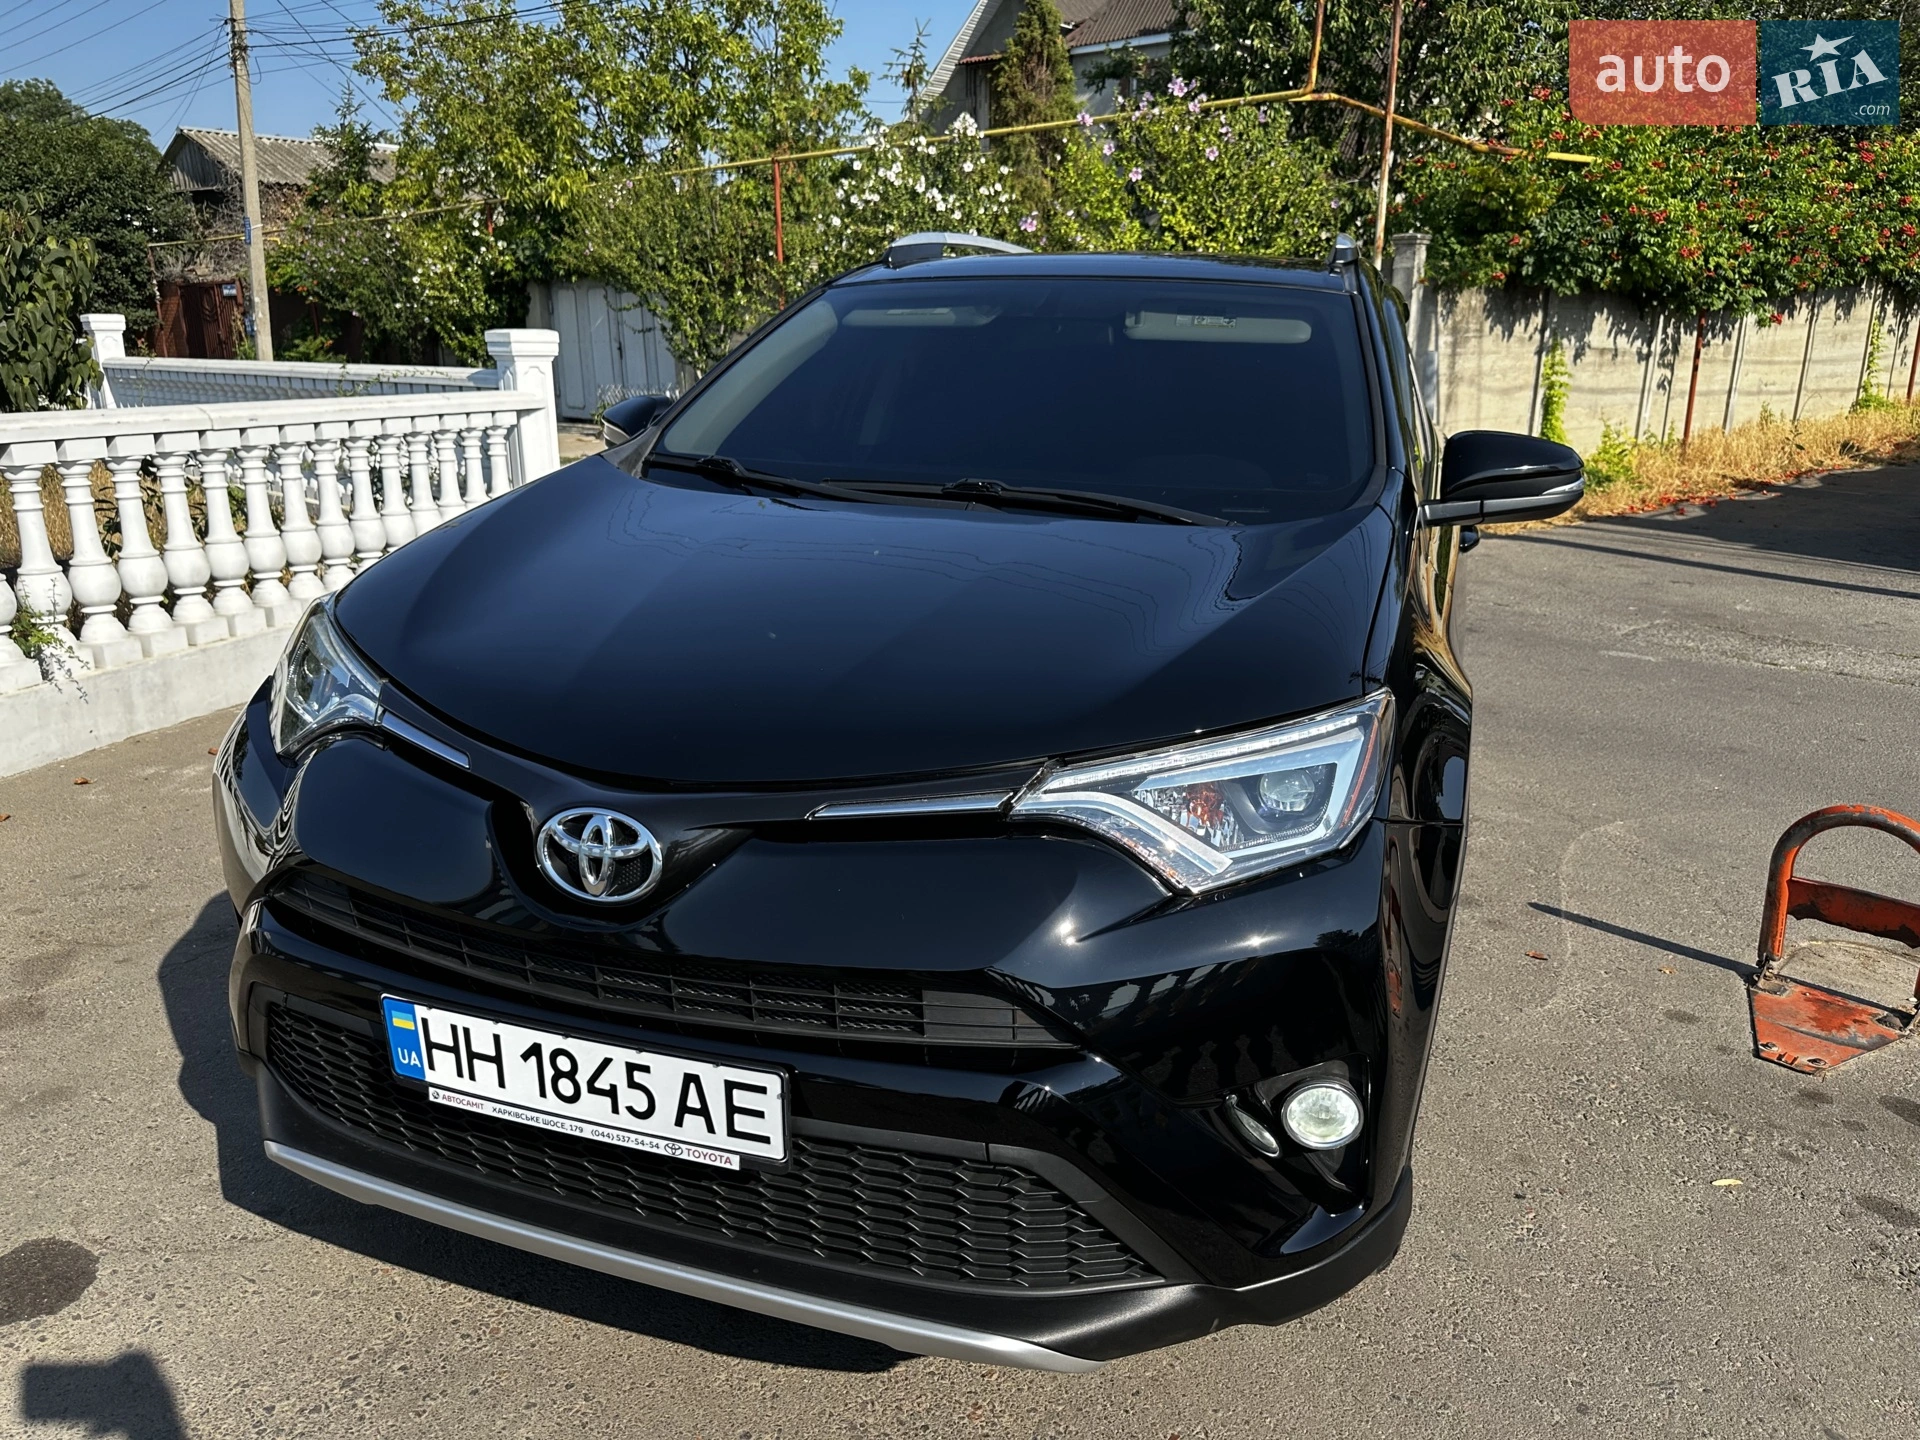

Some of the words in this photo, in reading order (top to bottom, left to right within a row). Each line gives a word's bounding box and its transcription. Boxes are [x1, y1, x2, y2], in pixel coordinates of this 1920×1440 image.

[397, 1047, 421, 1068] UA
[421, 1017, 505, 1089] HH
[520, 1042, 656, 1121] 1845
[674, 1071, 772, 1145] AE
[442, 1094, 484, 1110] АВТОСАМІТ
[492, 1106, 541, 1124] ХАРКІВСЬКЕ
[542, 1118, 568, 1131] ШОСЕ,
[569, 1124, 584, 1134] 179
[590, 1129, 615, 1141] (044)
[616, 1135, 660, 1150] 537-54-54
[685, 1147, 733, 1166] TOYOTA
